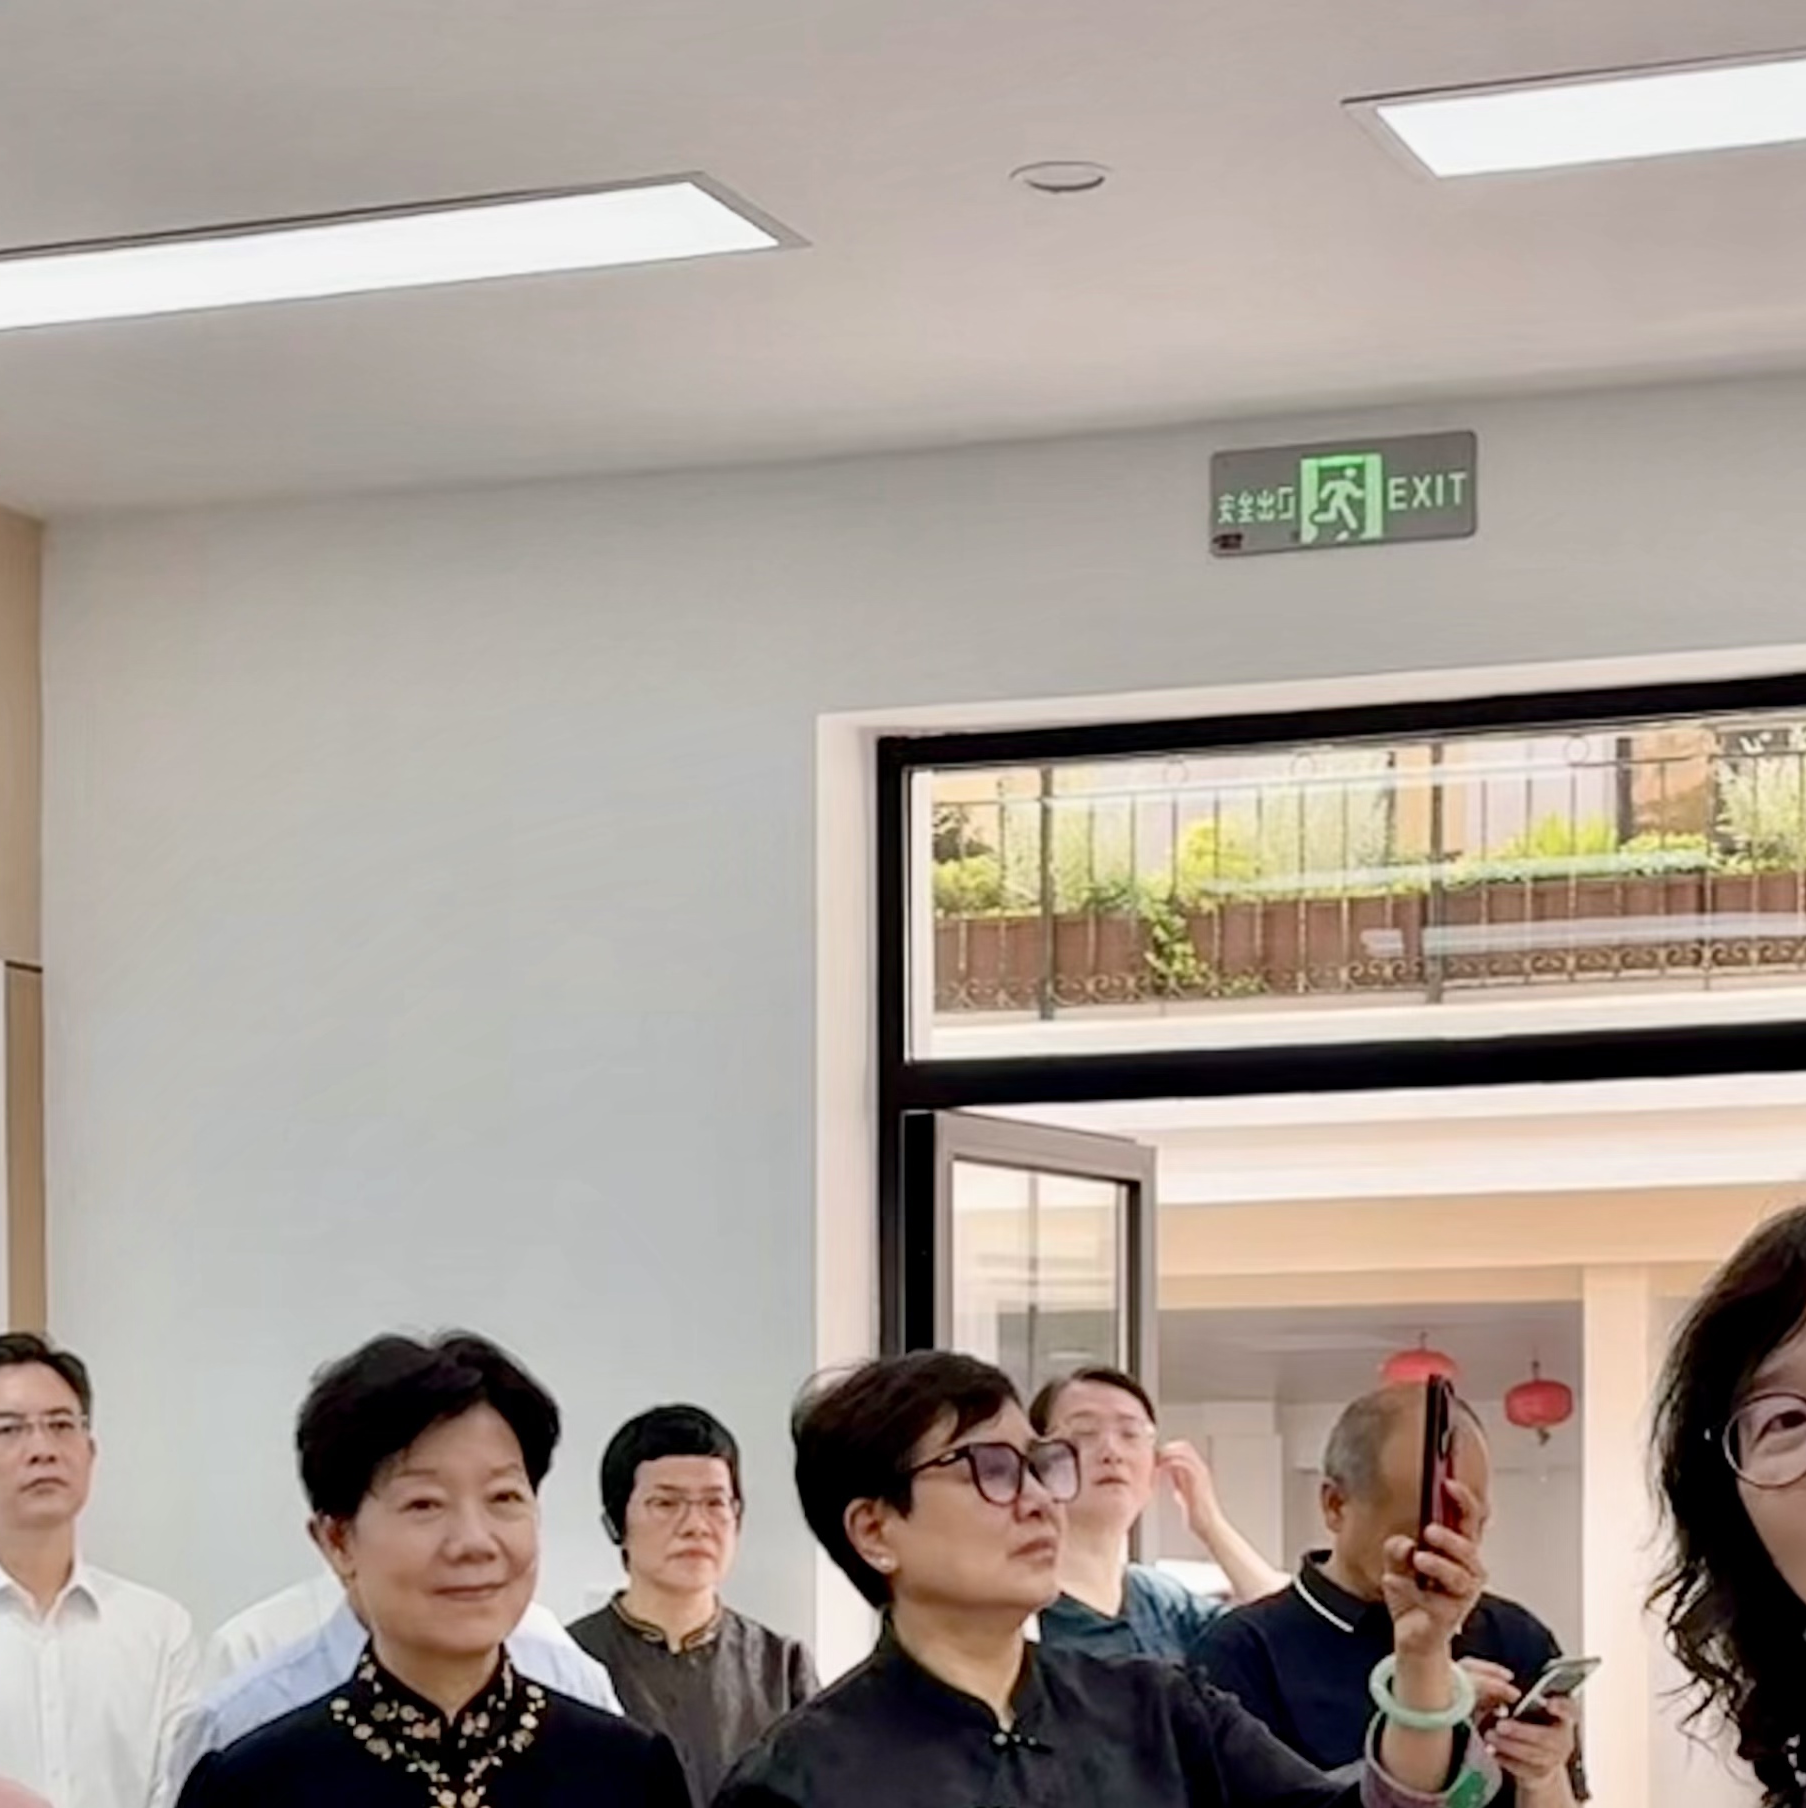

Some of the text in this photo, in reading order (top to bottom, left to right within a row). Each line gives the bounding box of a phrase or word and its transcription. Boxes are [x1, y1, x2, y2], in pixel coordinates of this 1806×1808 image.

[1217, 486, 1295, 524] 安全出口
[1387, 471, 1468, 511] EXIT
